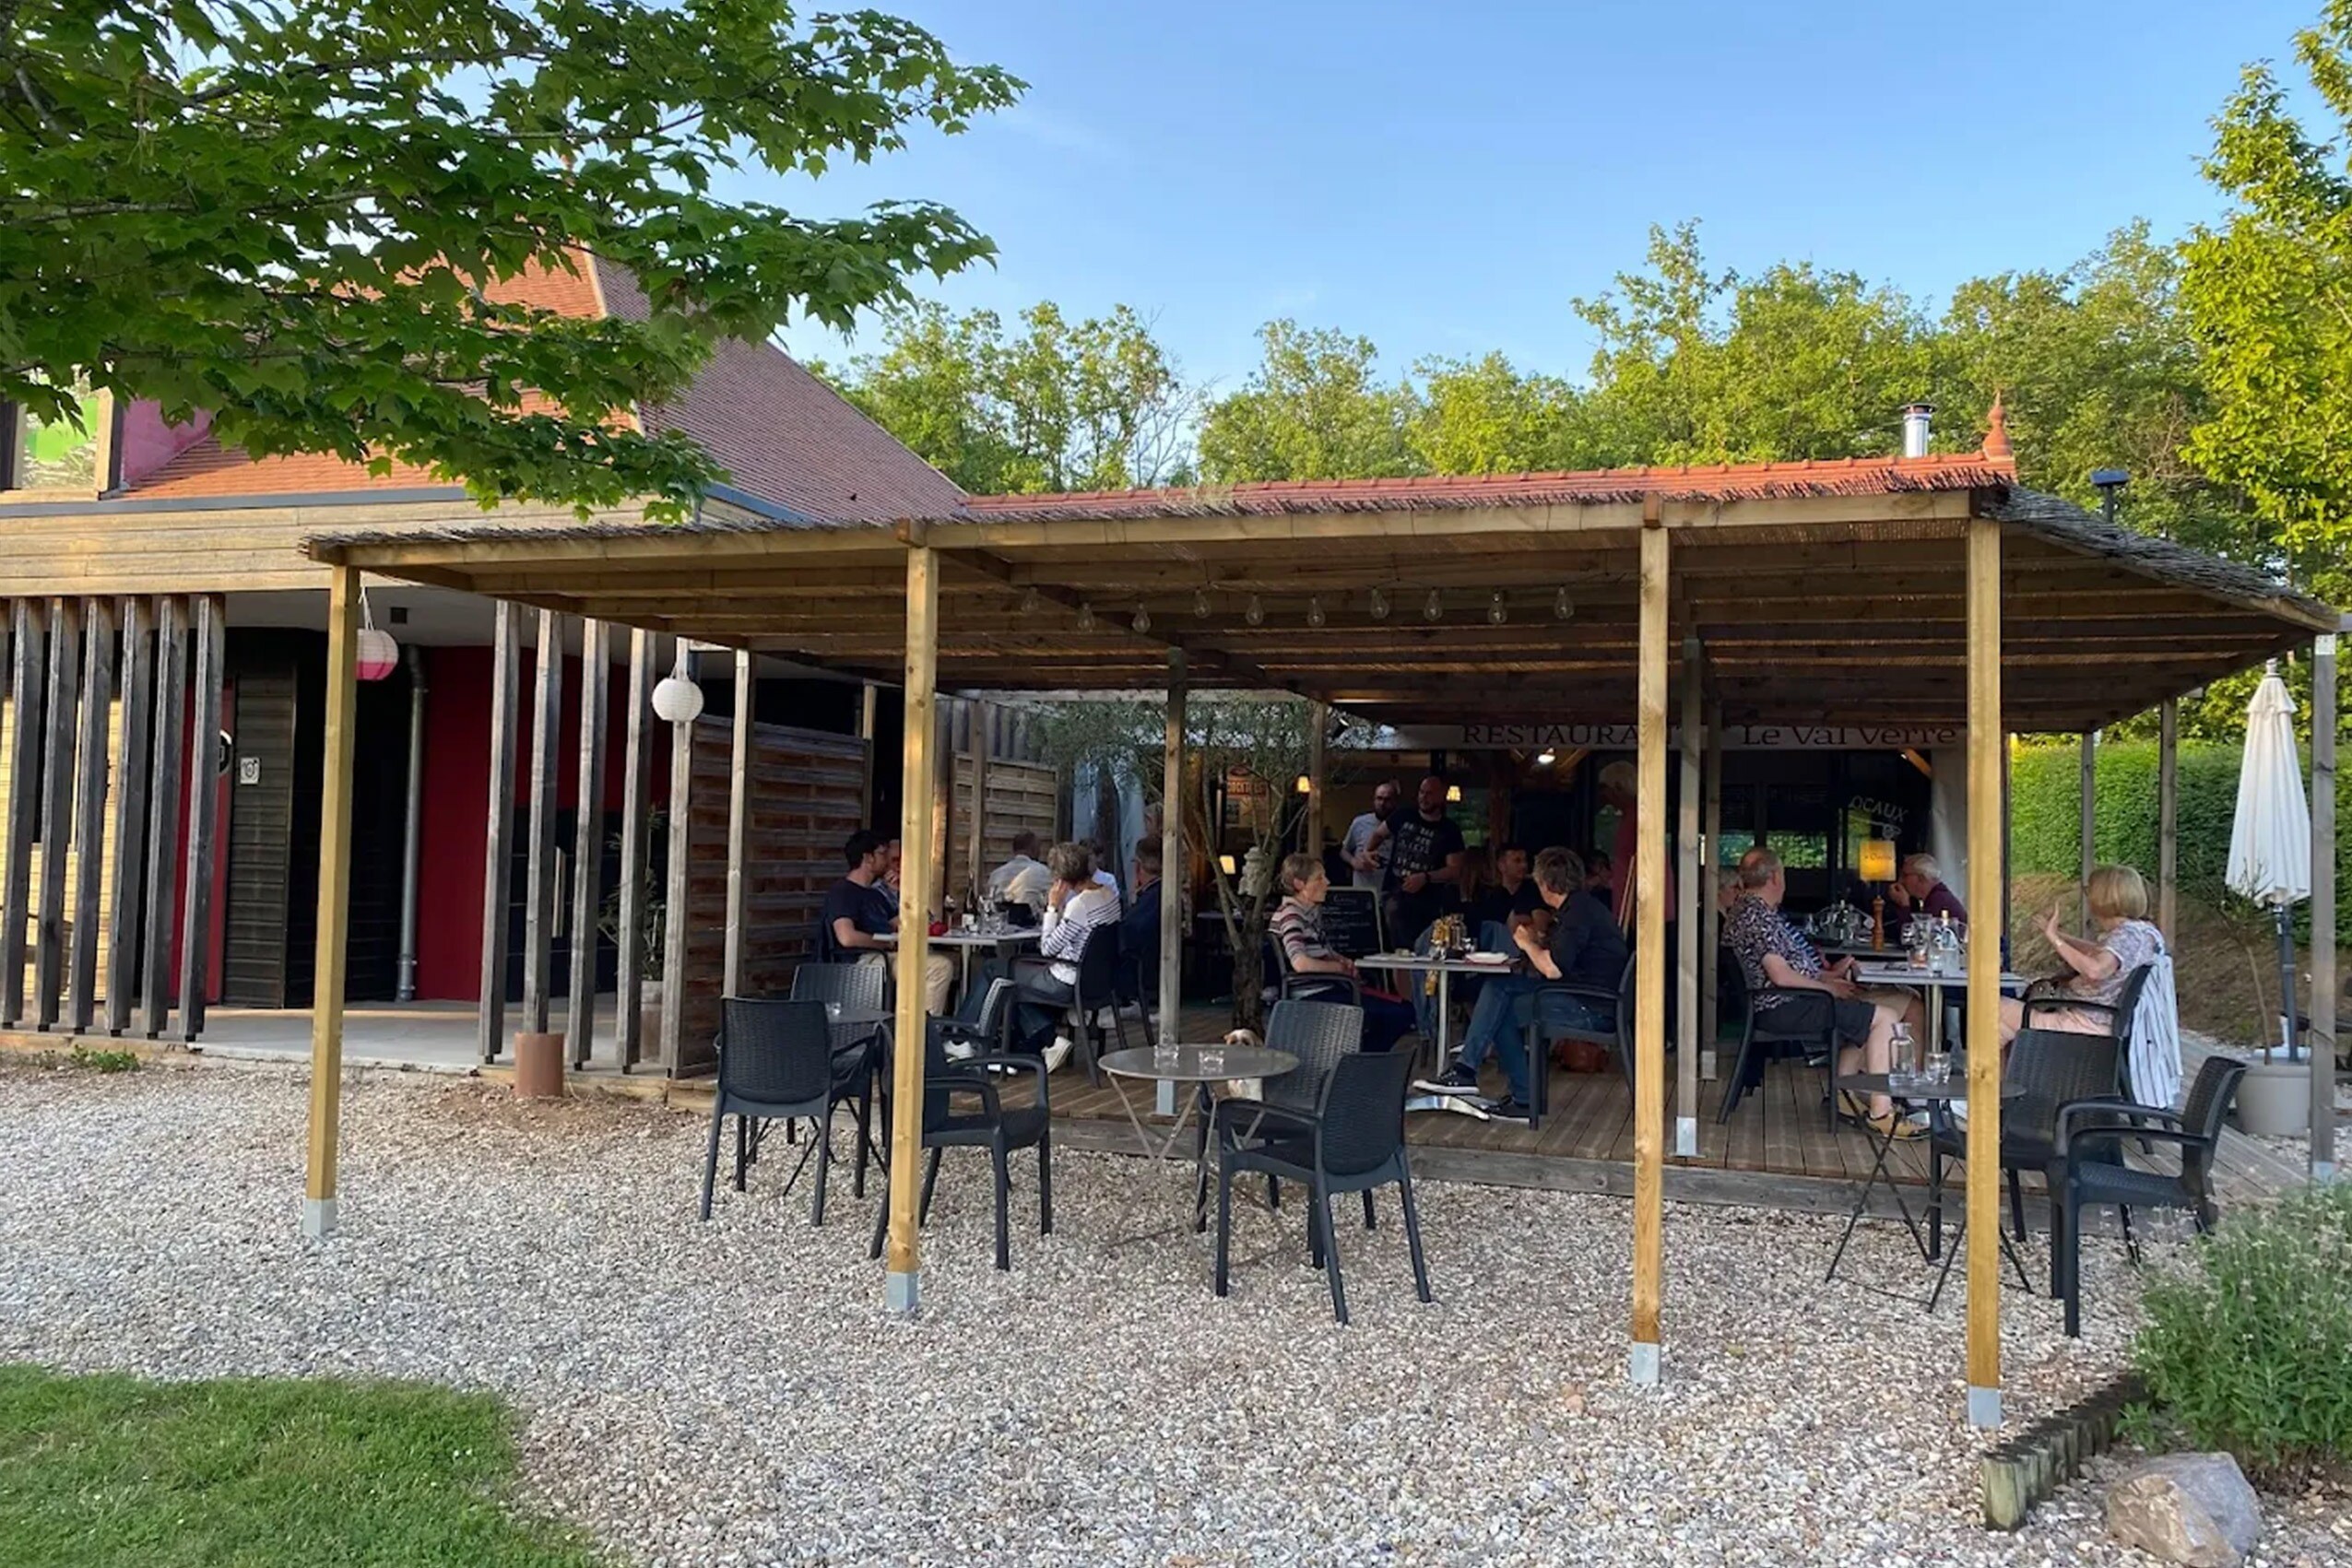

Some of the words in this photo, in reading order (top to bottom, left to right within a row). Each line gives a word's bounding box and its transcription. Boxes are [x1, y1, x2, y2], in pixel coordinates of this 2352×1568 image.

[1462, 725, 1679, 745] RESTAURAT
[1742, 725, 1780, 746] Le
[1791, 725, 1848, 746] Val
